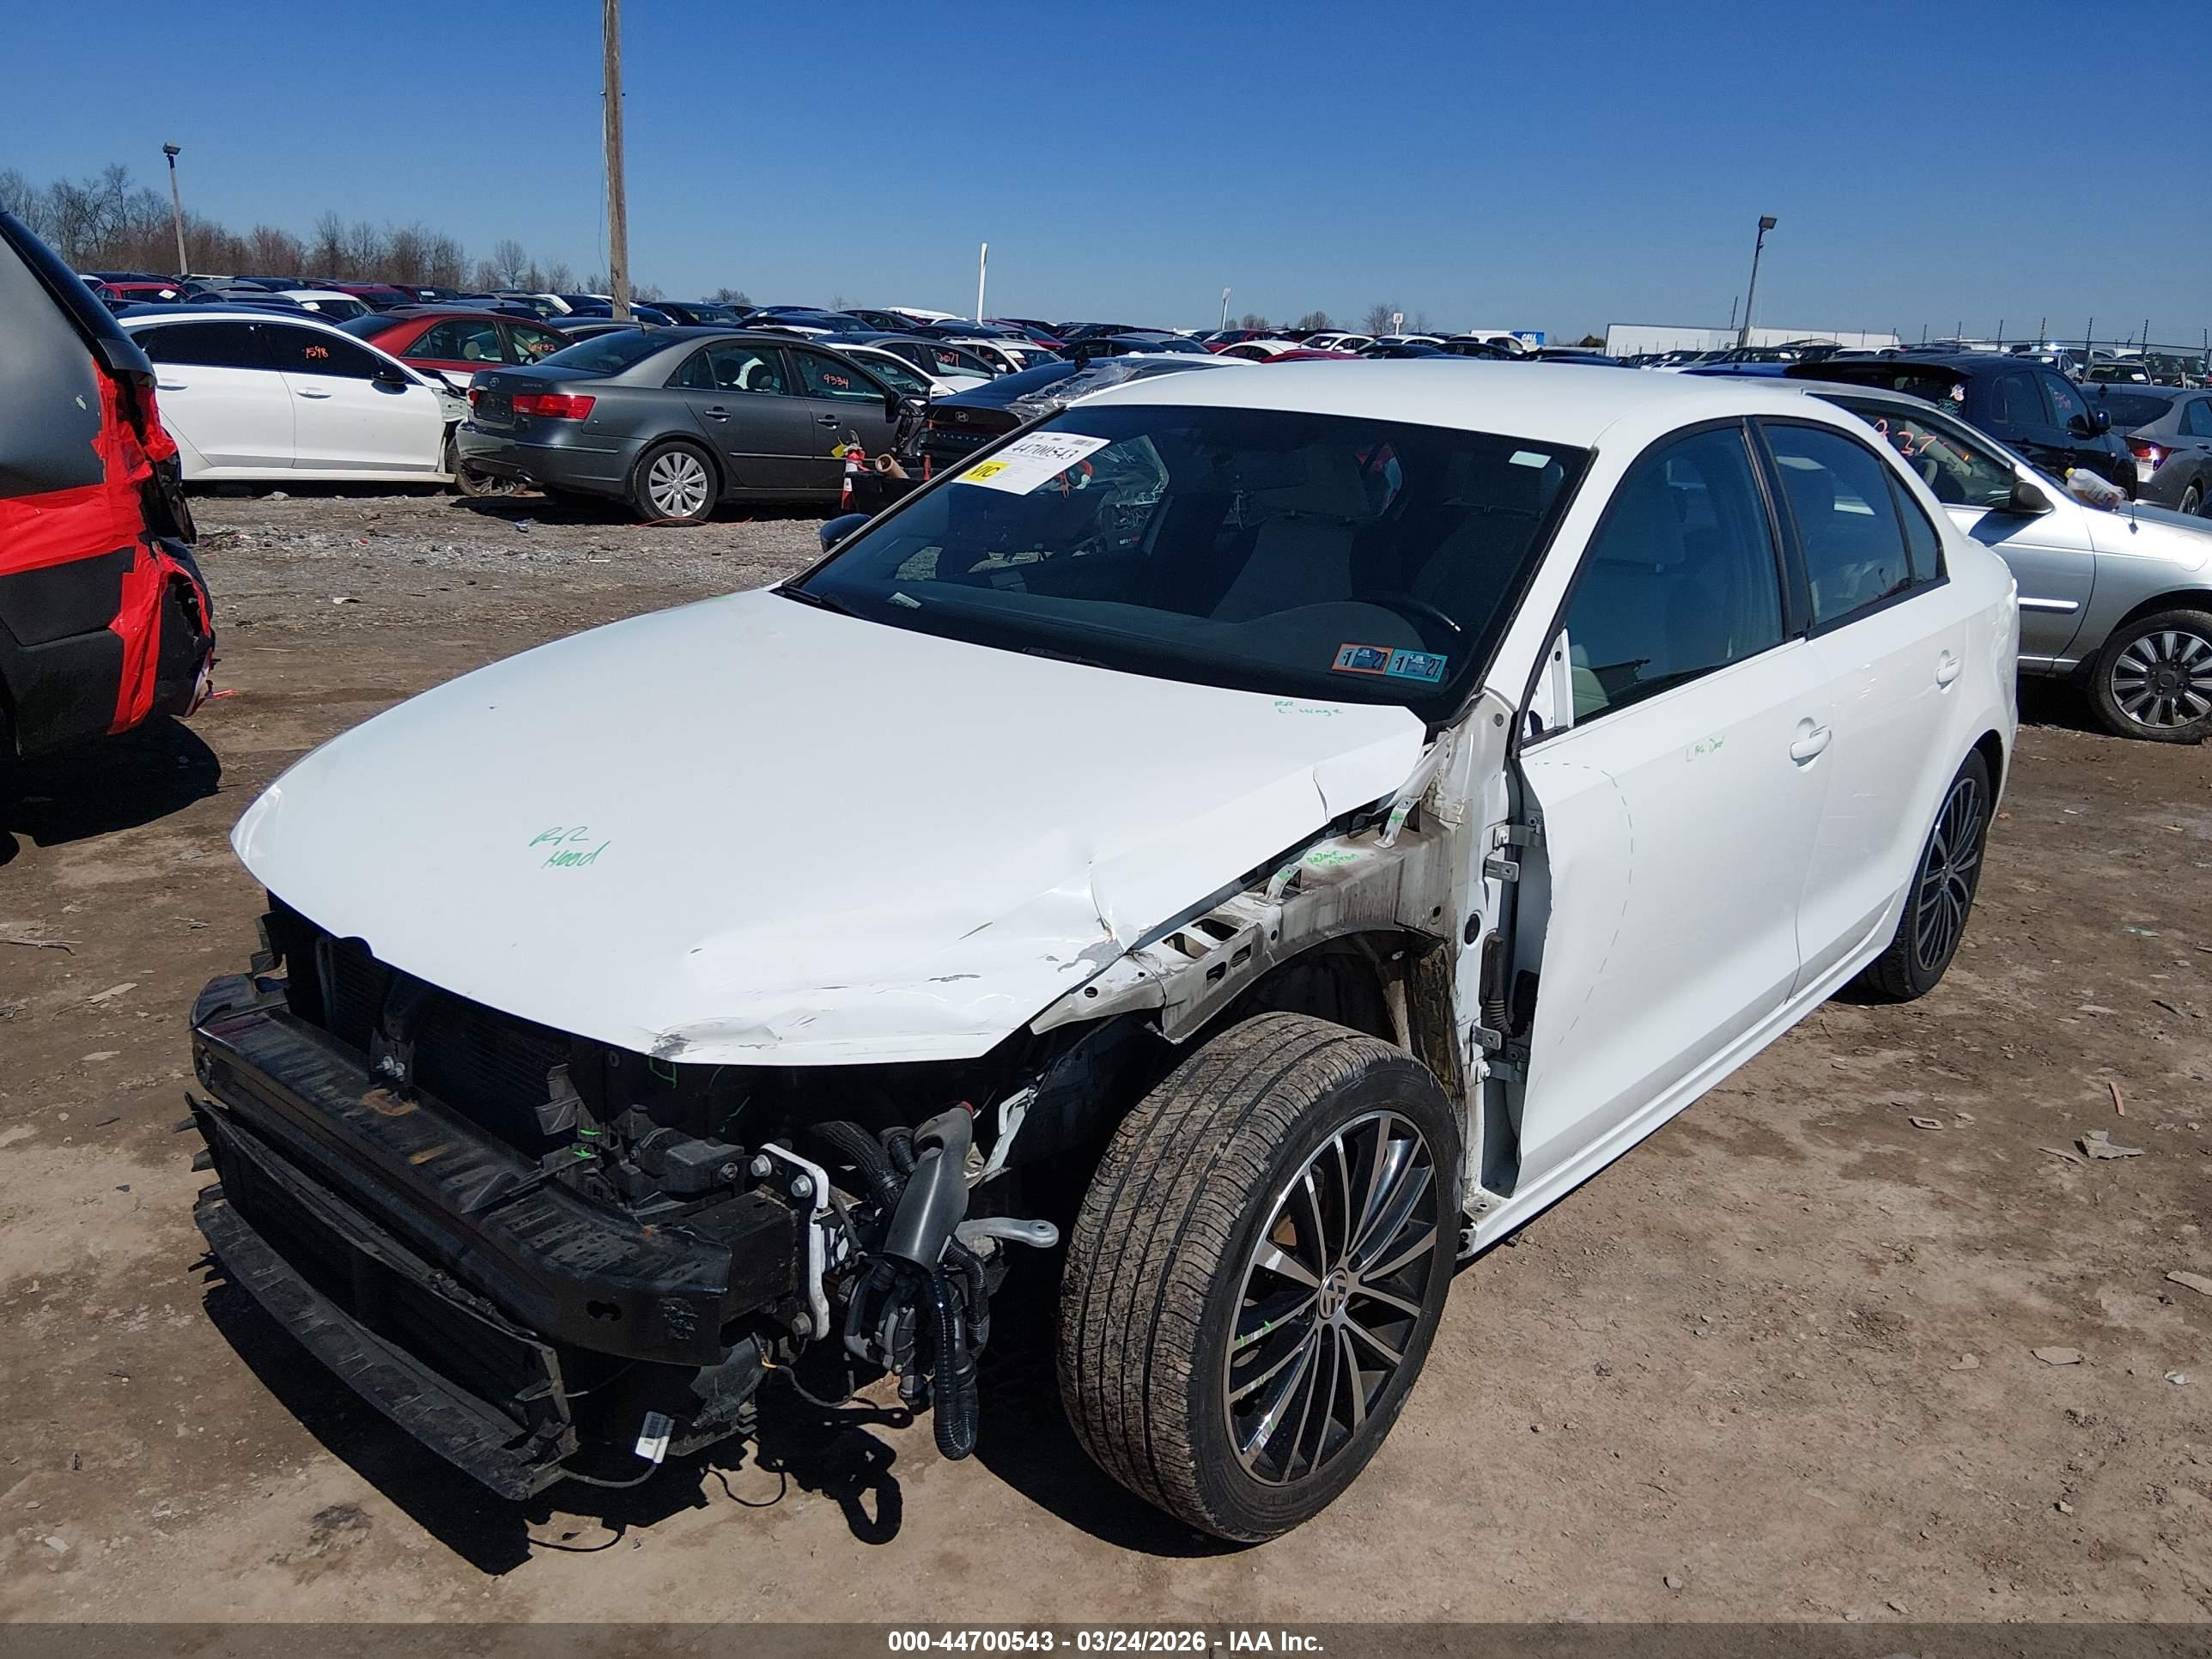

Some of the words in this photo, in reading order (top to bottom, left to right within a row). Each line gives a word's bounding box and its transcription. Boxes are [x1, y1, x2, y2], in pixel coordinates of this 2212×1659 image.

[823, 374, 848, 388] 9334
[969, 465, 1000, 478] VIC
[1425, 658, 1443, 678] 27
